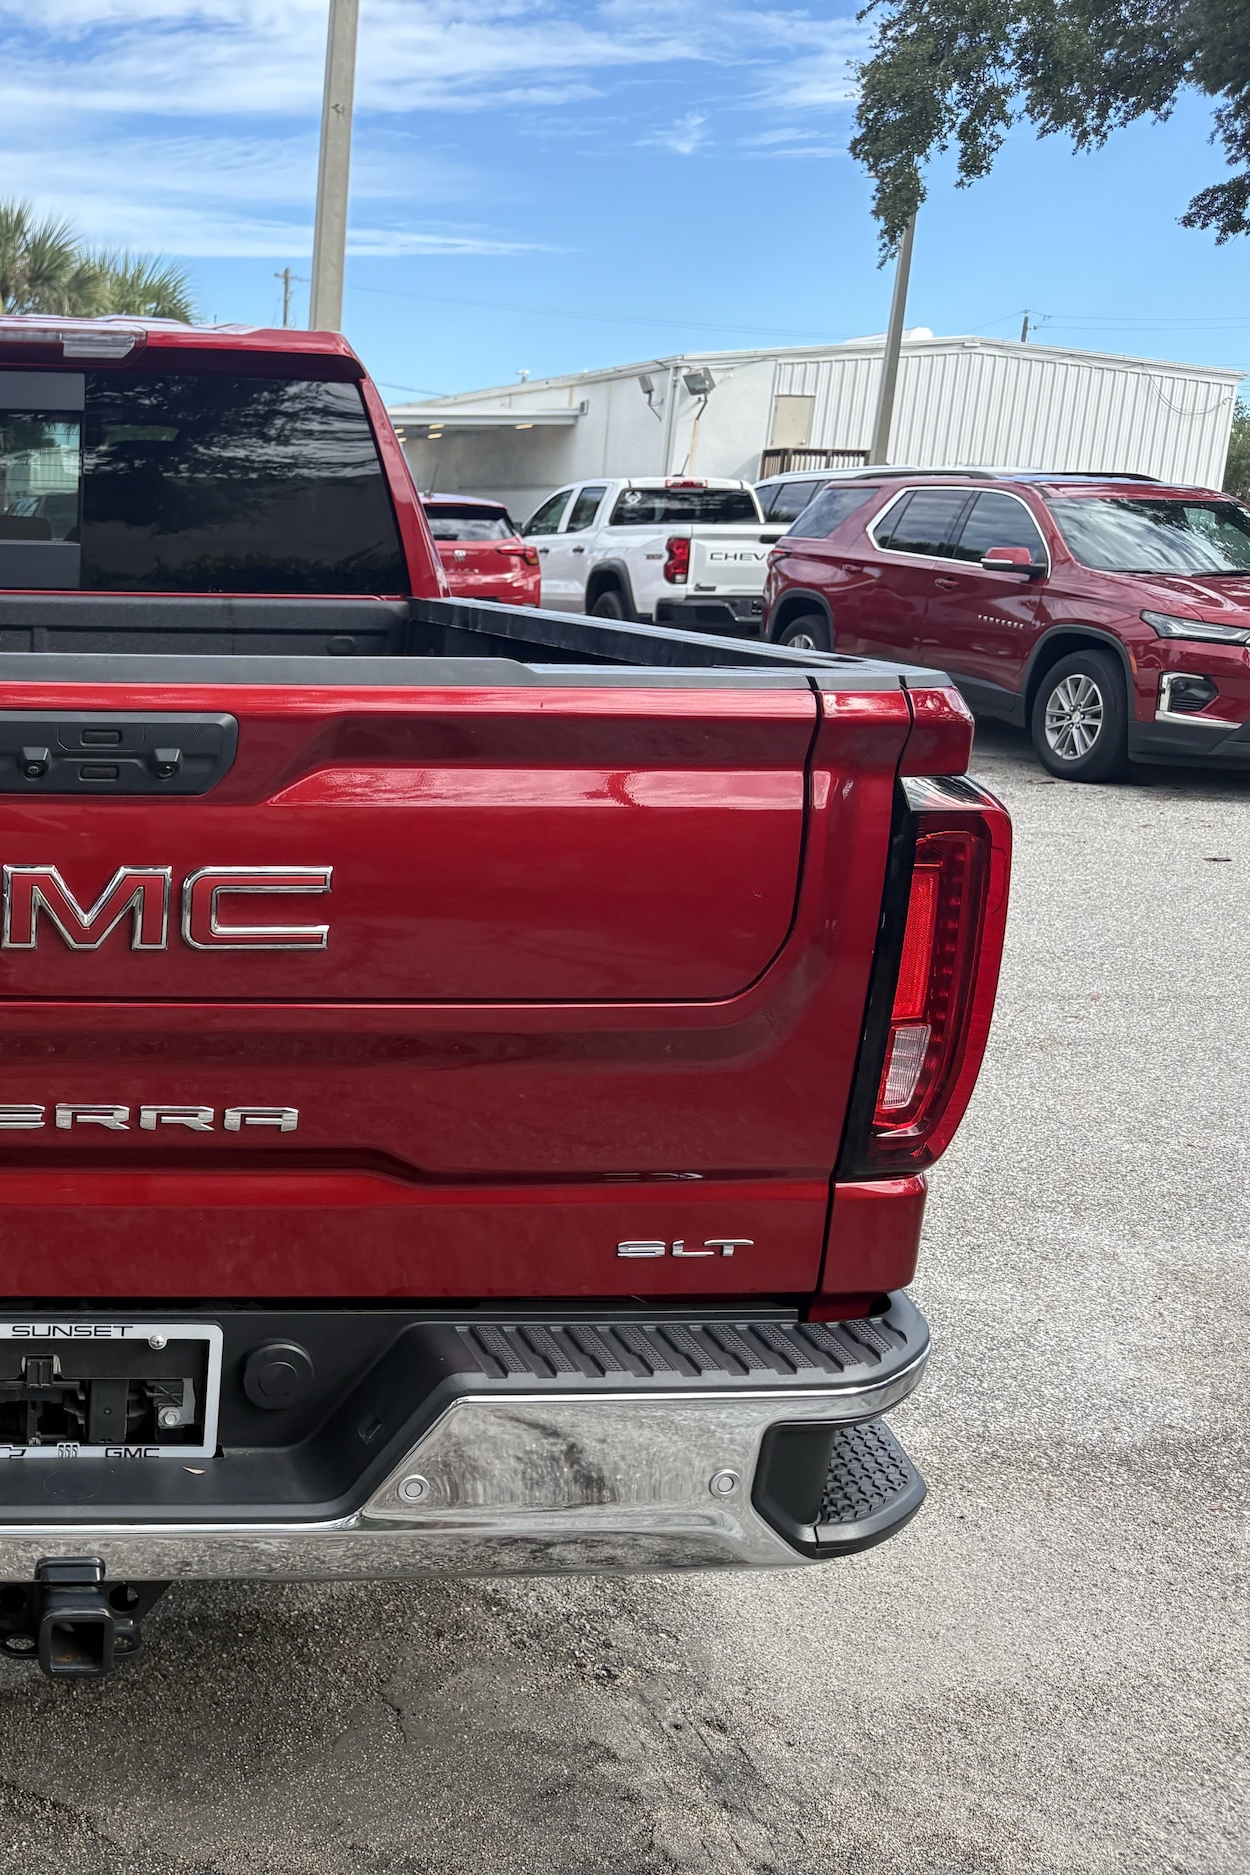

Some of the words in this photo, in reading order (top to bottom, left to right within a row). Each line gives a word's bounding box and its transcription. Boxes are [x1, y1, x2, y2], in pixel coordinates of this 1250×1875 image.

[710, 552, 766, 561] CHEV
[617, 1238, 754, 1257] SLT
[11, 1325, 133, 1337] SUNSET
[105, 1447, 160, 1458] GMC
